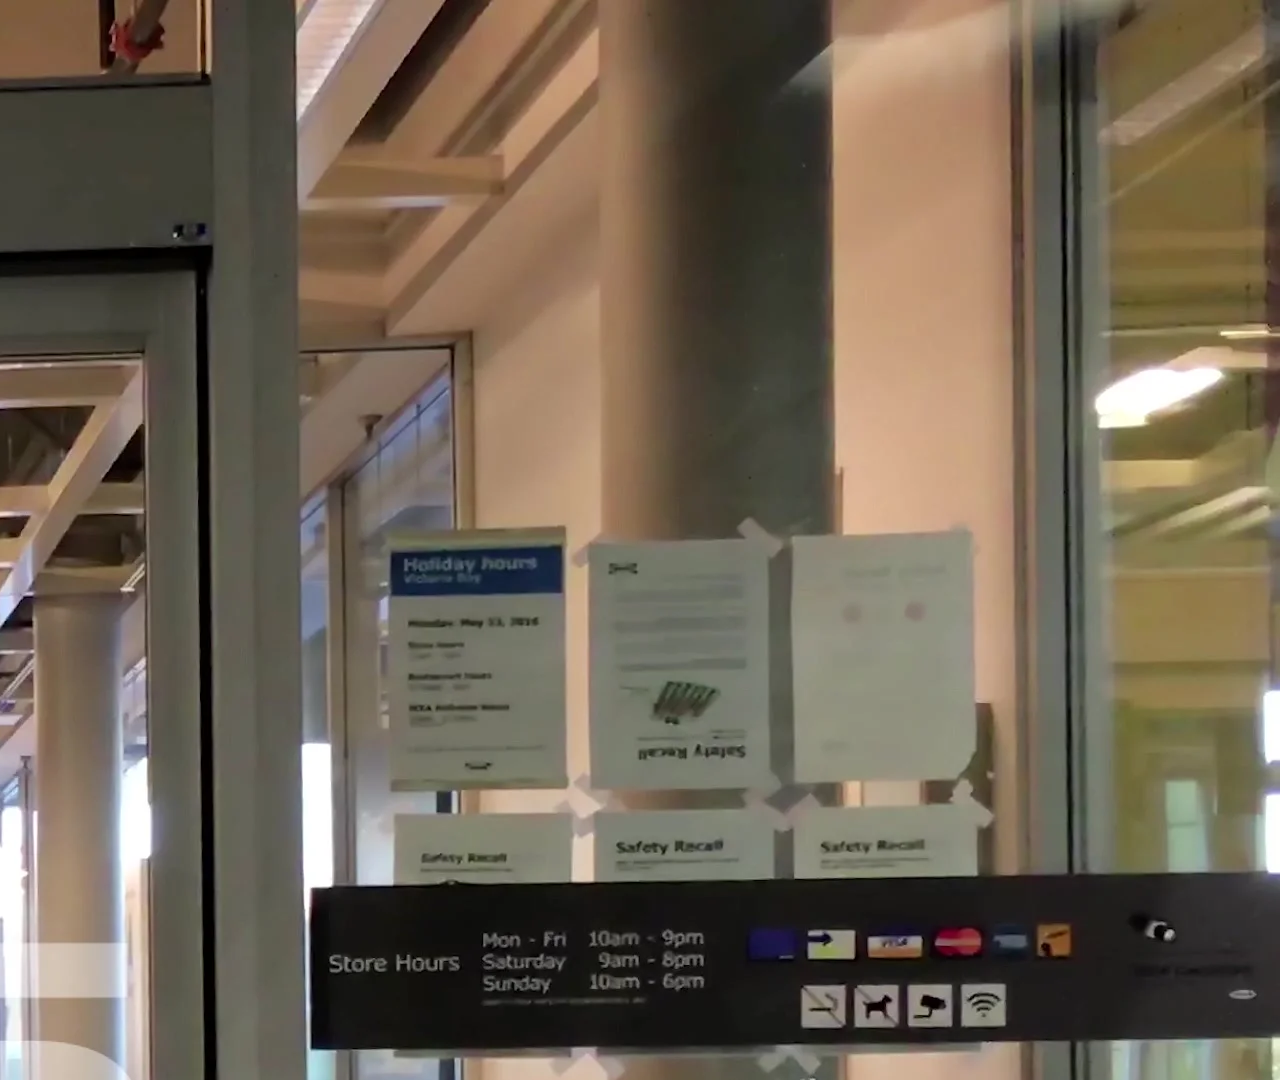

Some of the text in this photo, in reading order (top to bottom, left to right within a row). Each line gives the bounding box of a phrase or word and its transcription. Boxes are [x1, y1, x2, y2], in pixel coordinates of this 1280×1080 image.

[403, 556, 538, 574] Holiday hours
[615, 839, 724, 856] Safety Recall
[820, 838, 925, 855] Safety Recall
[420, 851, 508, 866] Safety Recall
[482, 931, 522, 948] Mon
[543, 930, 567, 948] Fri
[587, 929, 640, 947] 10am
[661, 929, 705, 948] 9pm
[328, 953, 461, 974] Store Hours
[482, 953, 567, 973] Saturday
[598, 952, 640, 969] 9am
[661, 952, 705, 970] 8pm
[482, 974, 552, 994] Sunday
[589, 974, 640, 991] 10am
[662, 974, 705, 992] 6pm
